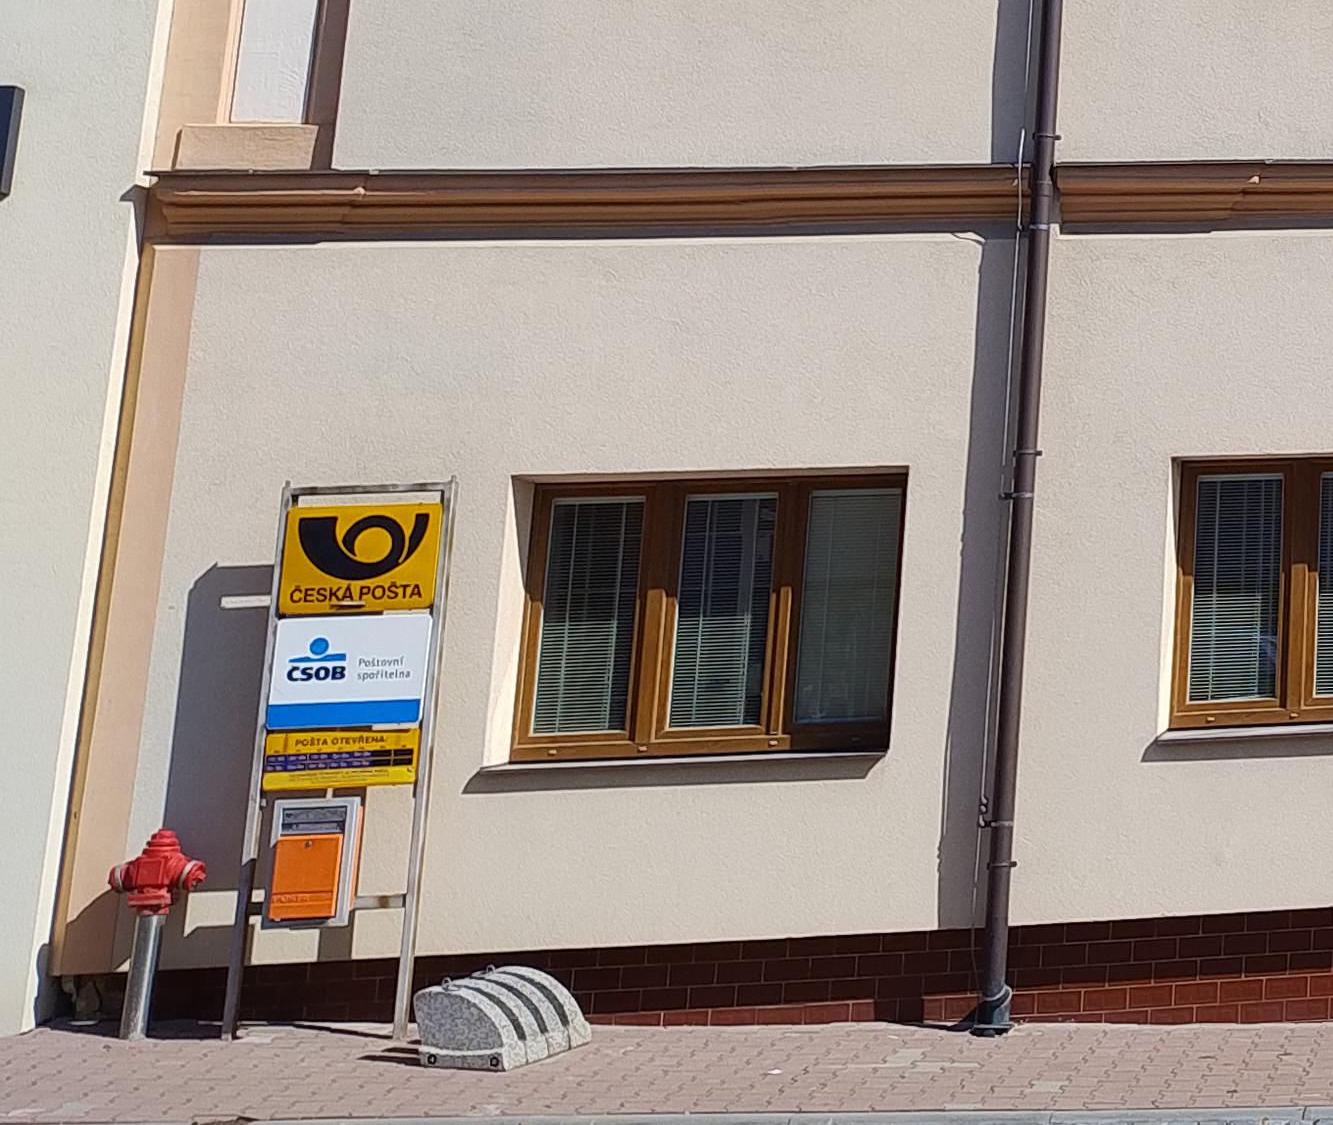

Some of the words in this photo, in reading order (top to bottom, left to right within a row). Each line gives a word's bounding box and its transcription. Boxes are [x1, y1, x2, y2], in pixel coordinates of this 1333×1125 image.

[289, 583, 354, 604] ČESKÁ
[358, 581, 423, 602] POŠTA
[358, 655, 404, 668] Poštovní
[286, 665, 346, 682] ČSOB
[356, 668, 411, 682] spořitelna
[294, 736, 328, 748] POŠTA
[331, 734, 386, 746] OTEVŘENA
